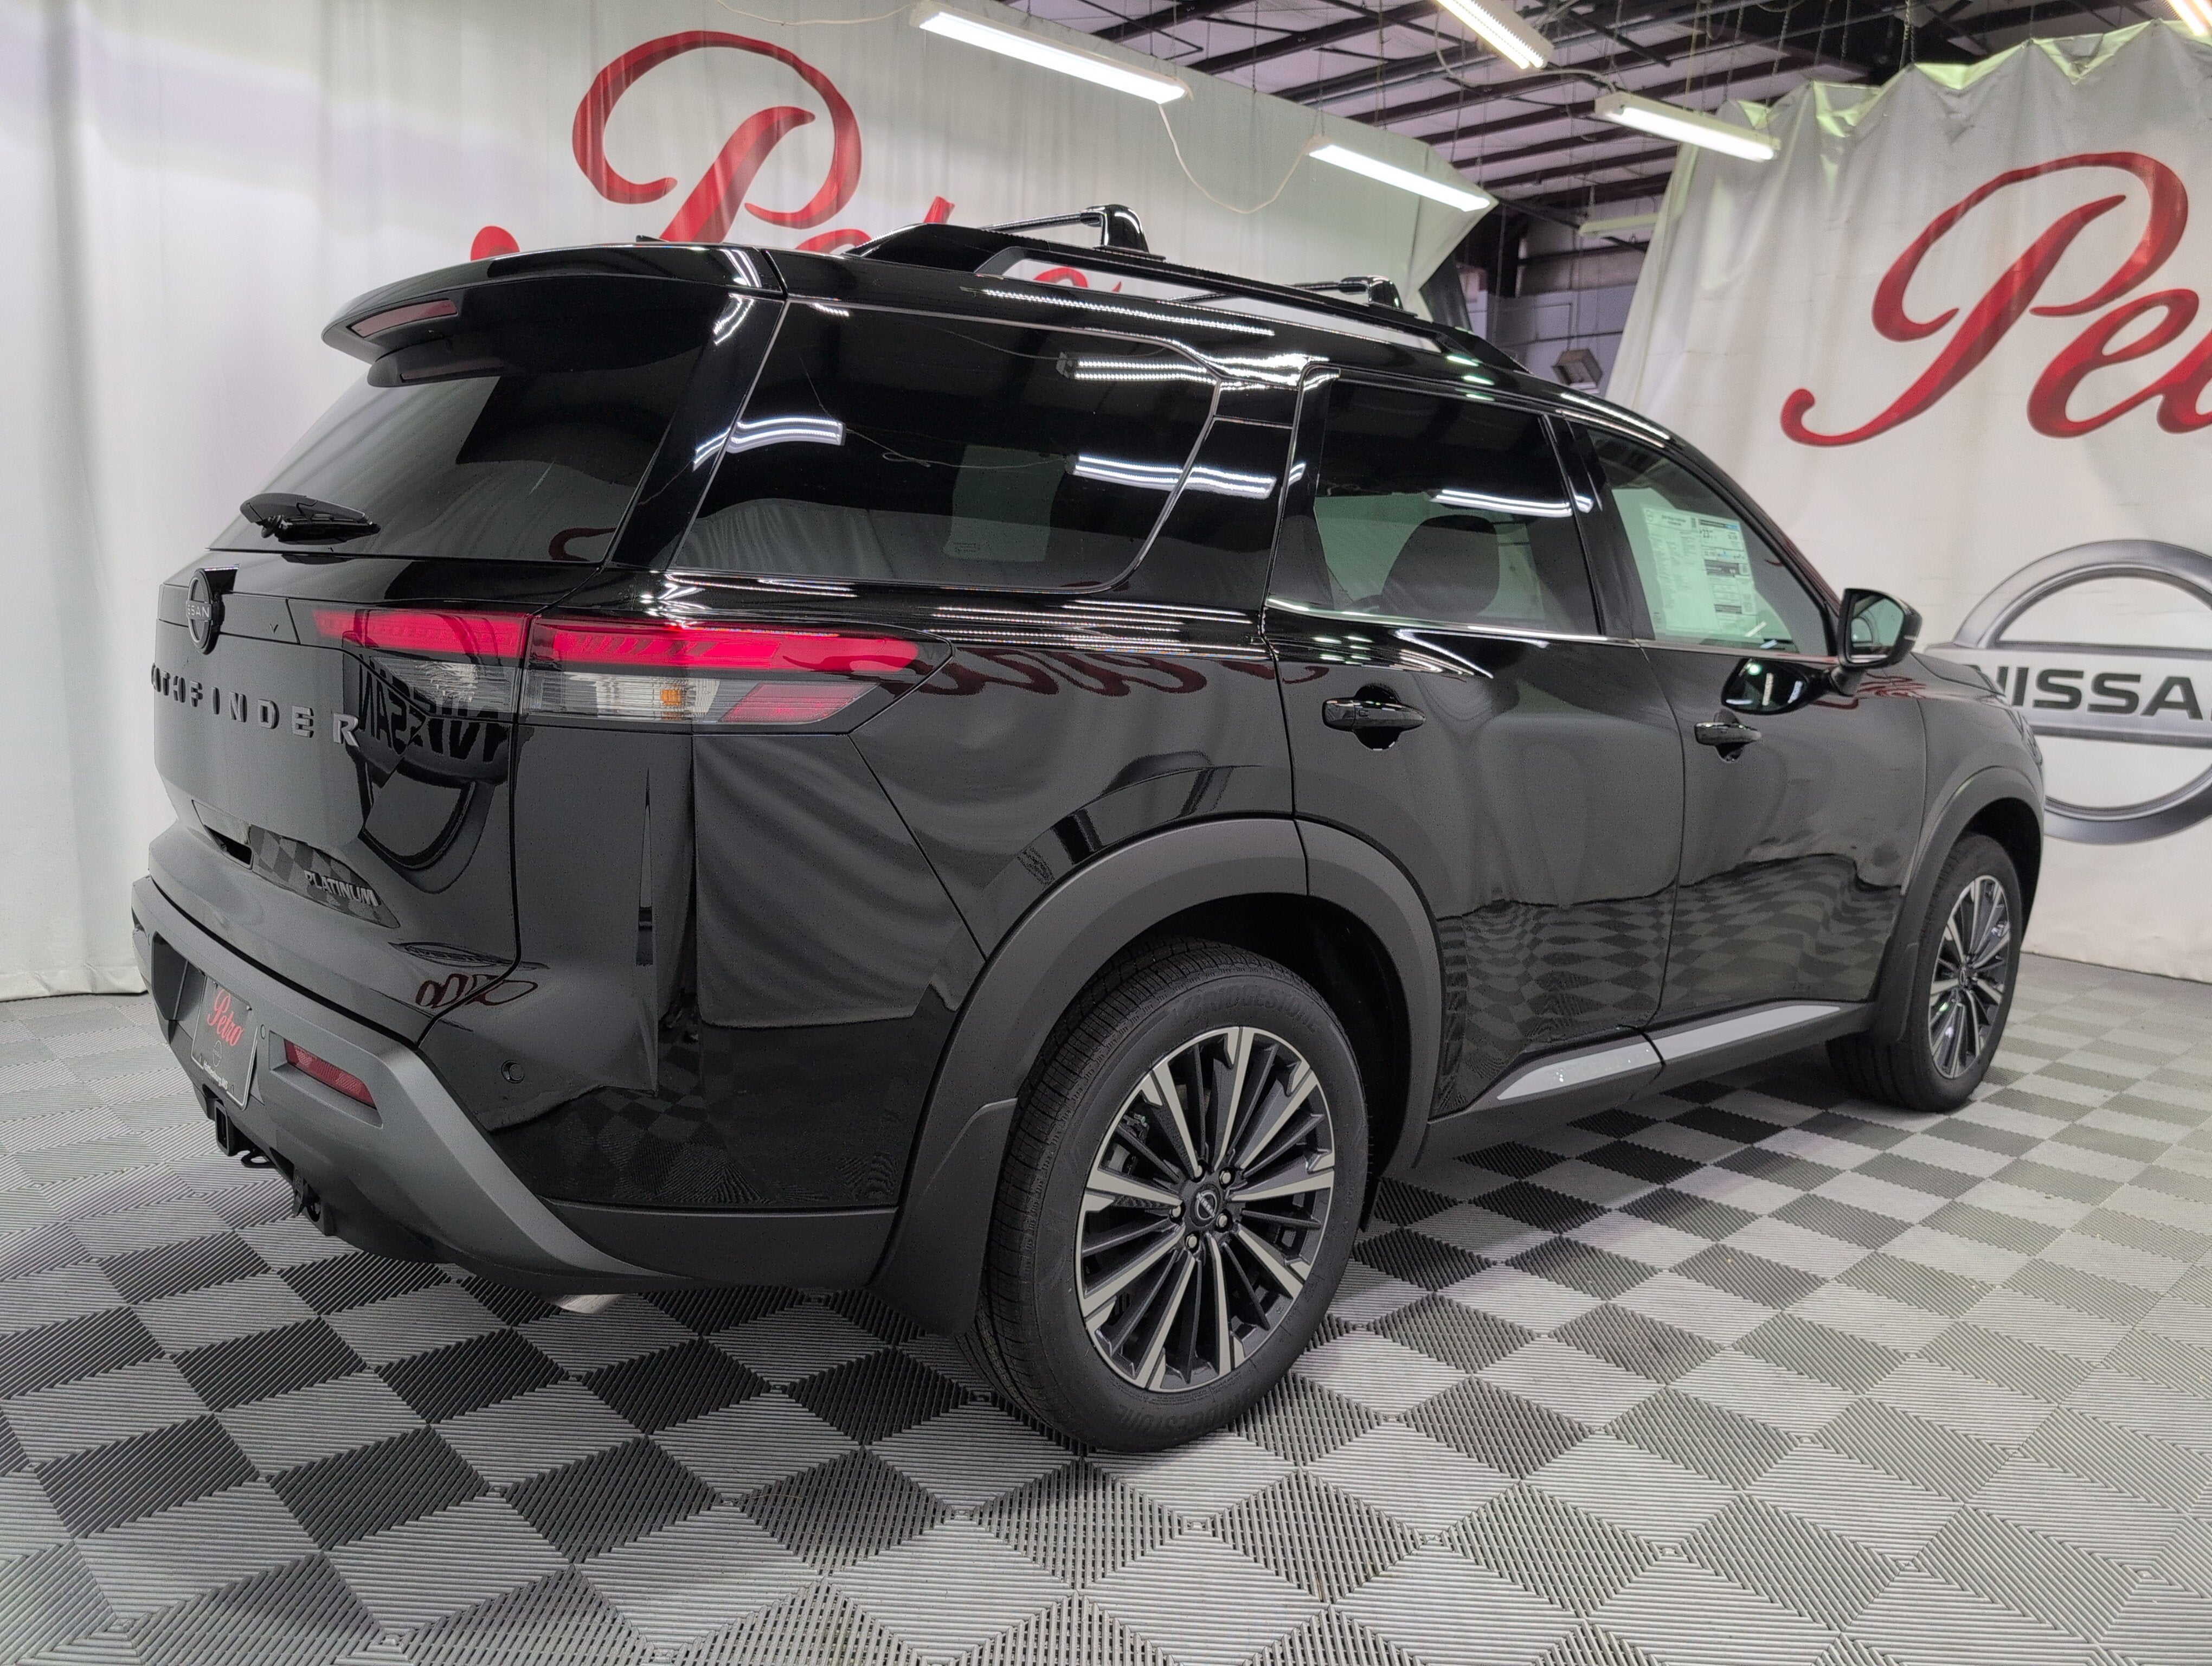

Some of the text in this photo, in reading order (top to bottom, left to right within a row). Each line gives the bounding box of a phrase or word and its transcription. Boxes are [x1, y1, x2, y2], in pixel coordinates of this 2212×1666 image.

[151, 662, 359, 747] ATHFINDER
[1963, 664, 2212, 721] ISSA
[303, 869, 379, 907] PLATINUM
[207, 988, 245, 1047] Petro
